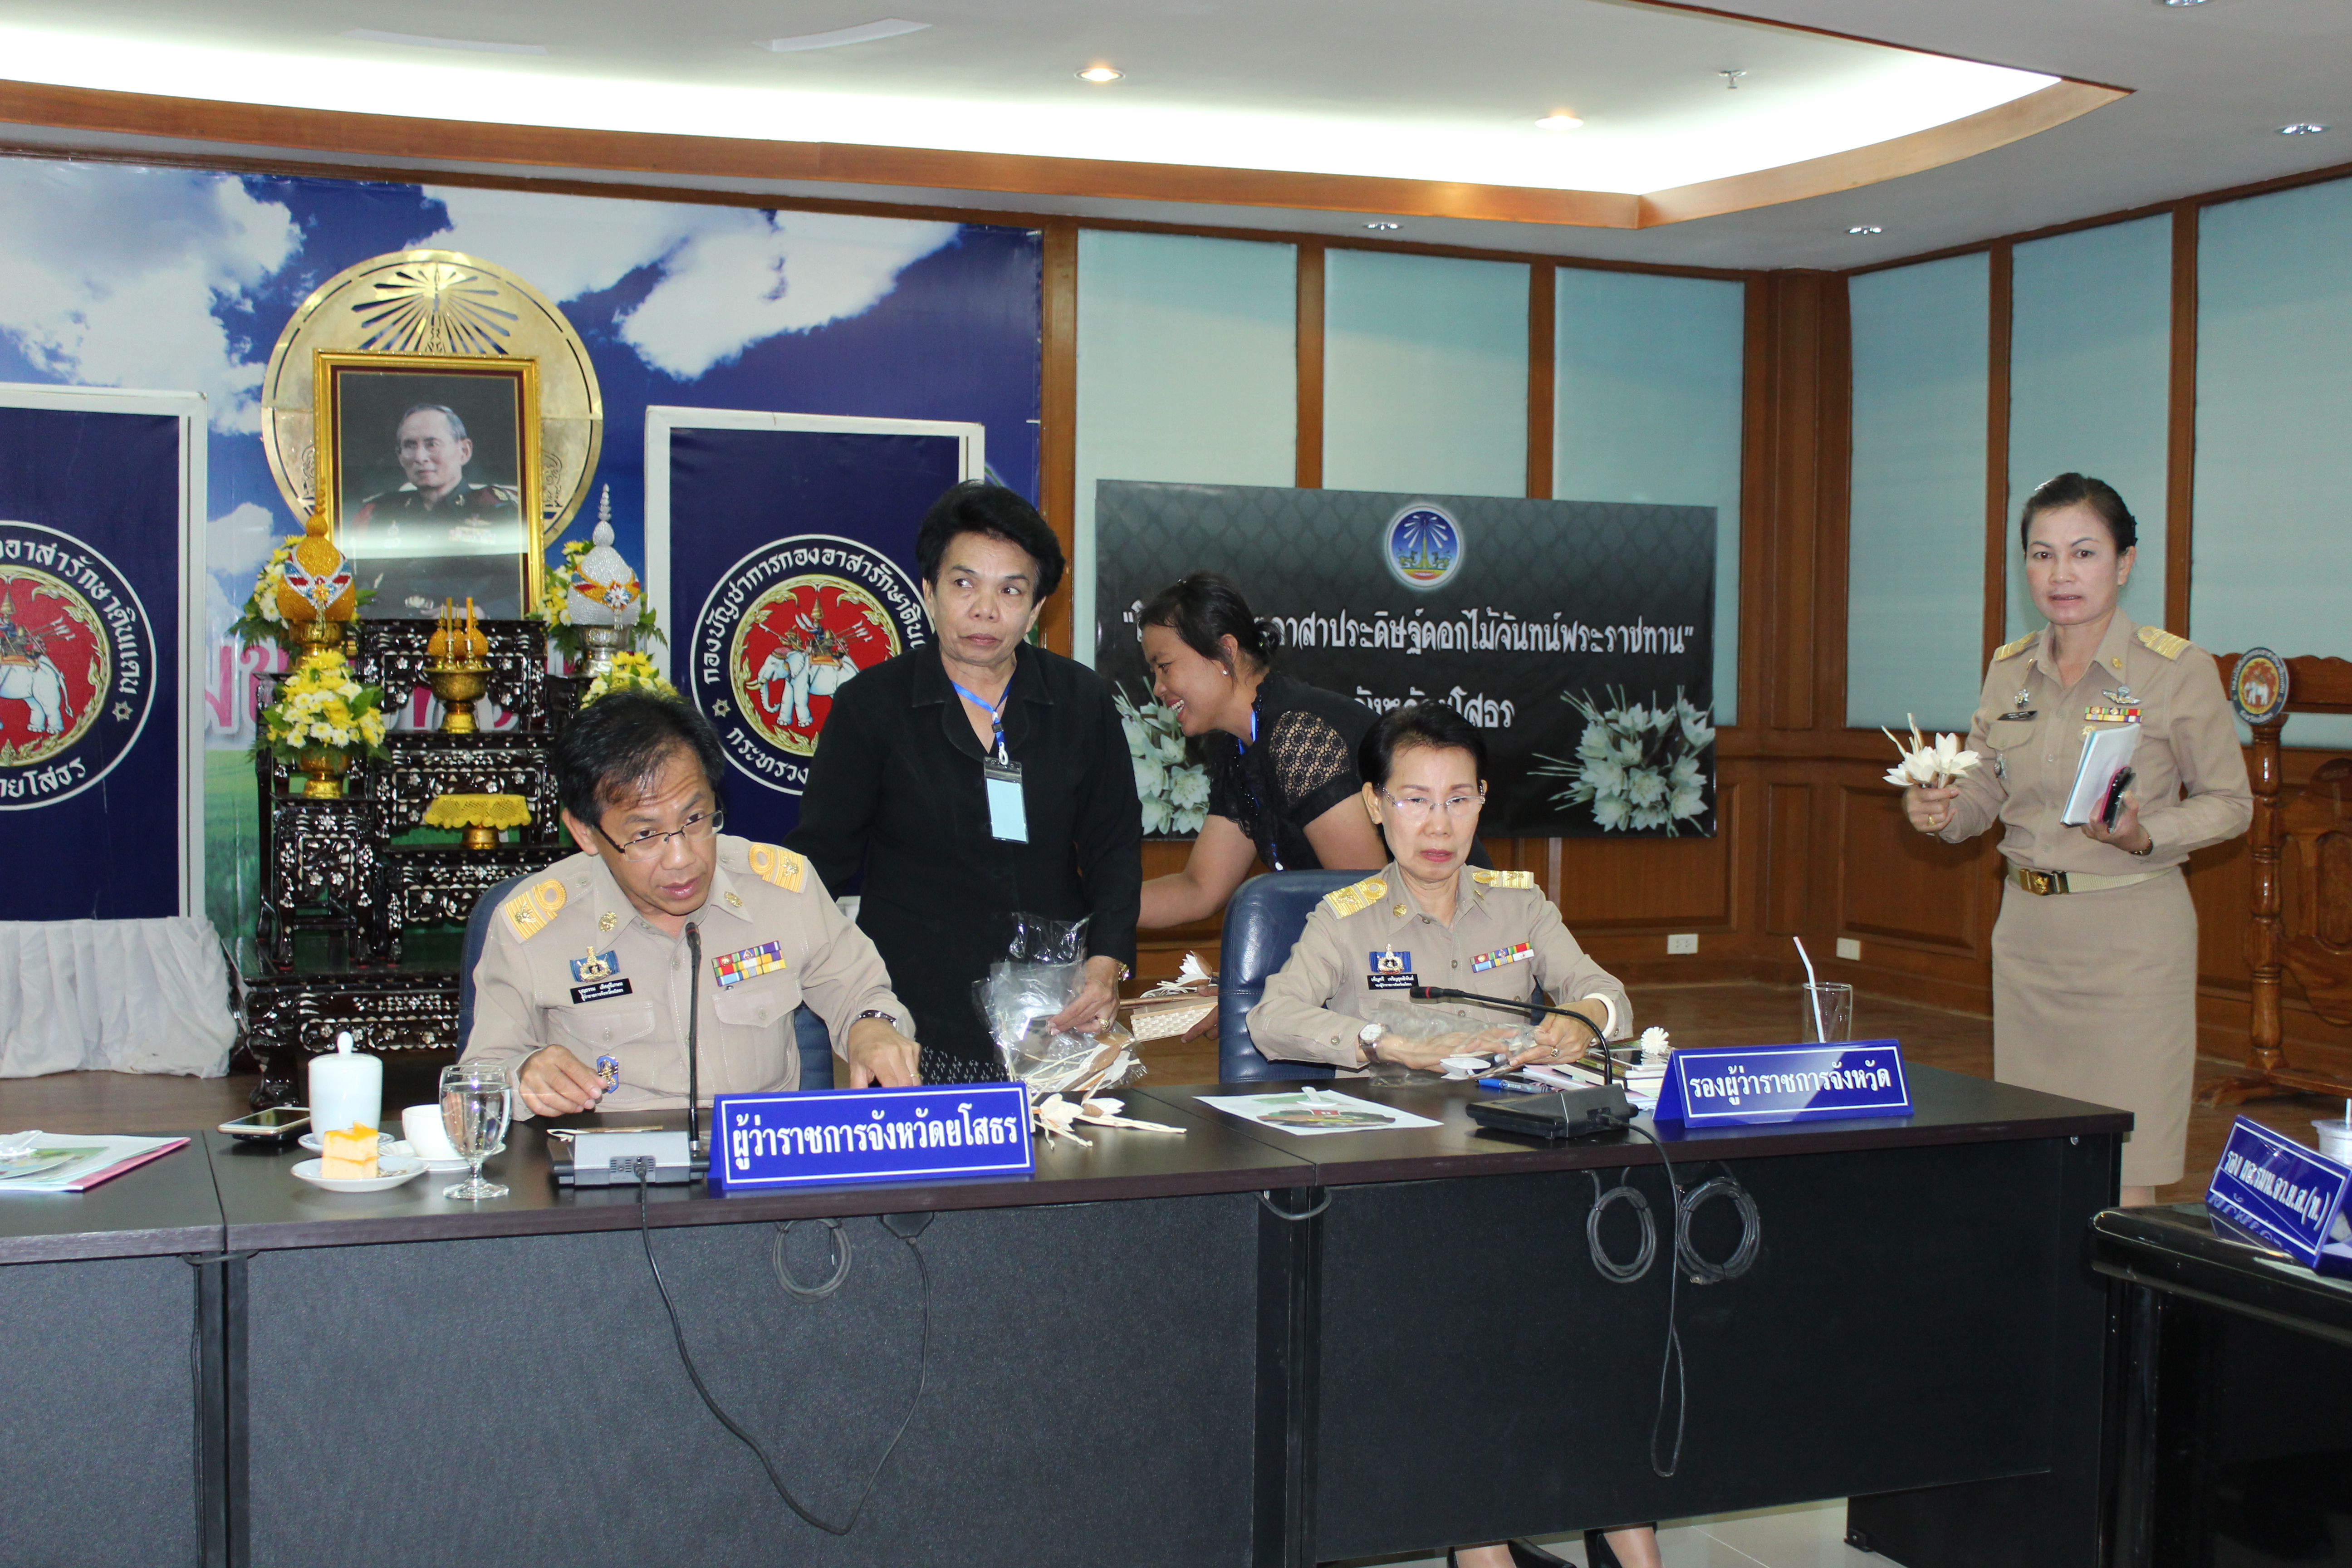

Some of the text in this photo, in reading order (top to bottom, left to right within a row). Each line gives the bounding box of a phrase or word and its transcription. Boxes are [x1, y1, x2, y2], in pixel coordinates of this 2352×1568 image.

[1690, 1059, 1891, 1106] รองผู้ว่าราชการจังหวัด
[732, 1102, 1018, 1170] ผู้ว่าราชการจังหวัดยโสธร
[2224, 1150, 2243, 1177] รอง
